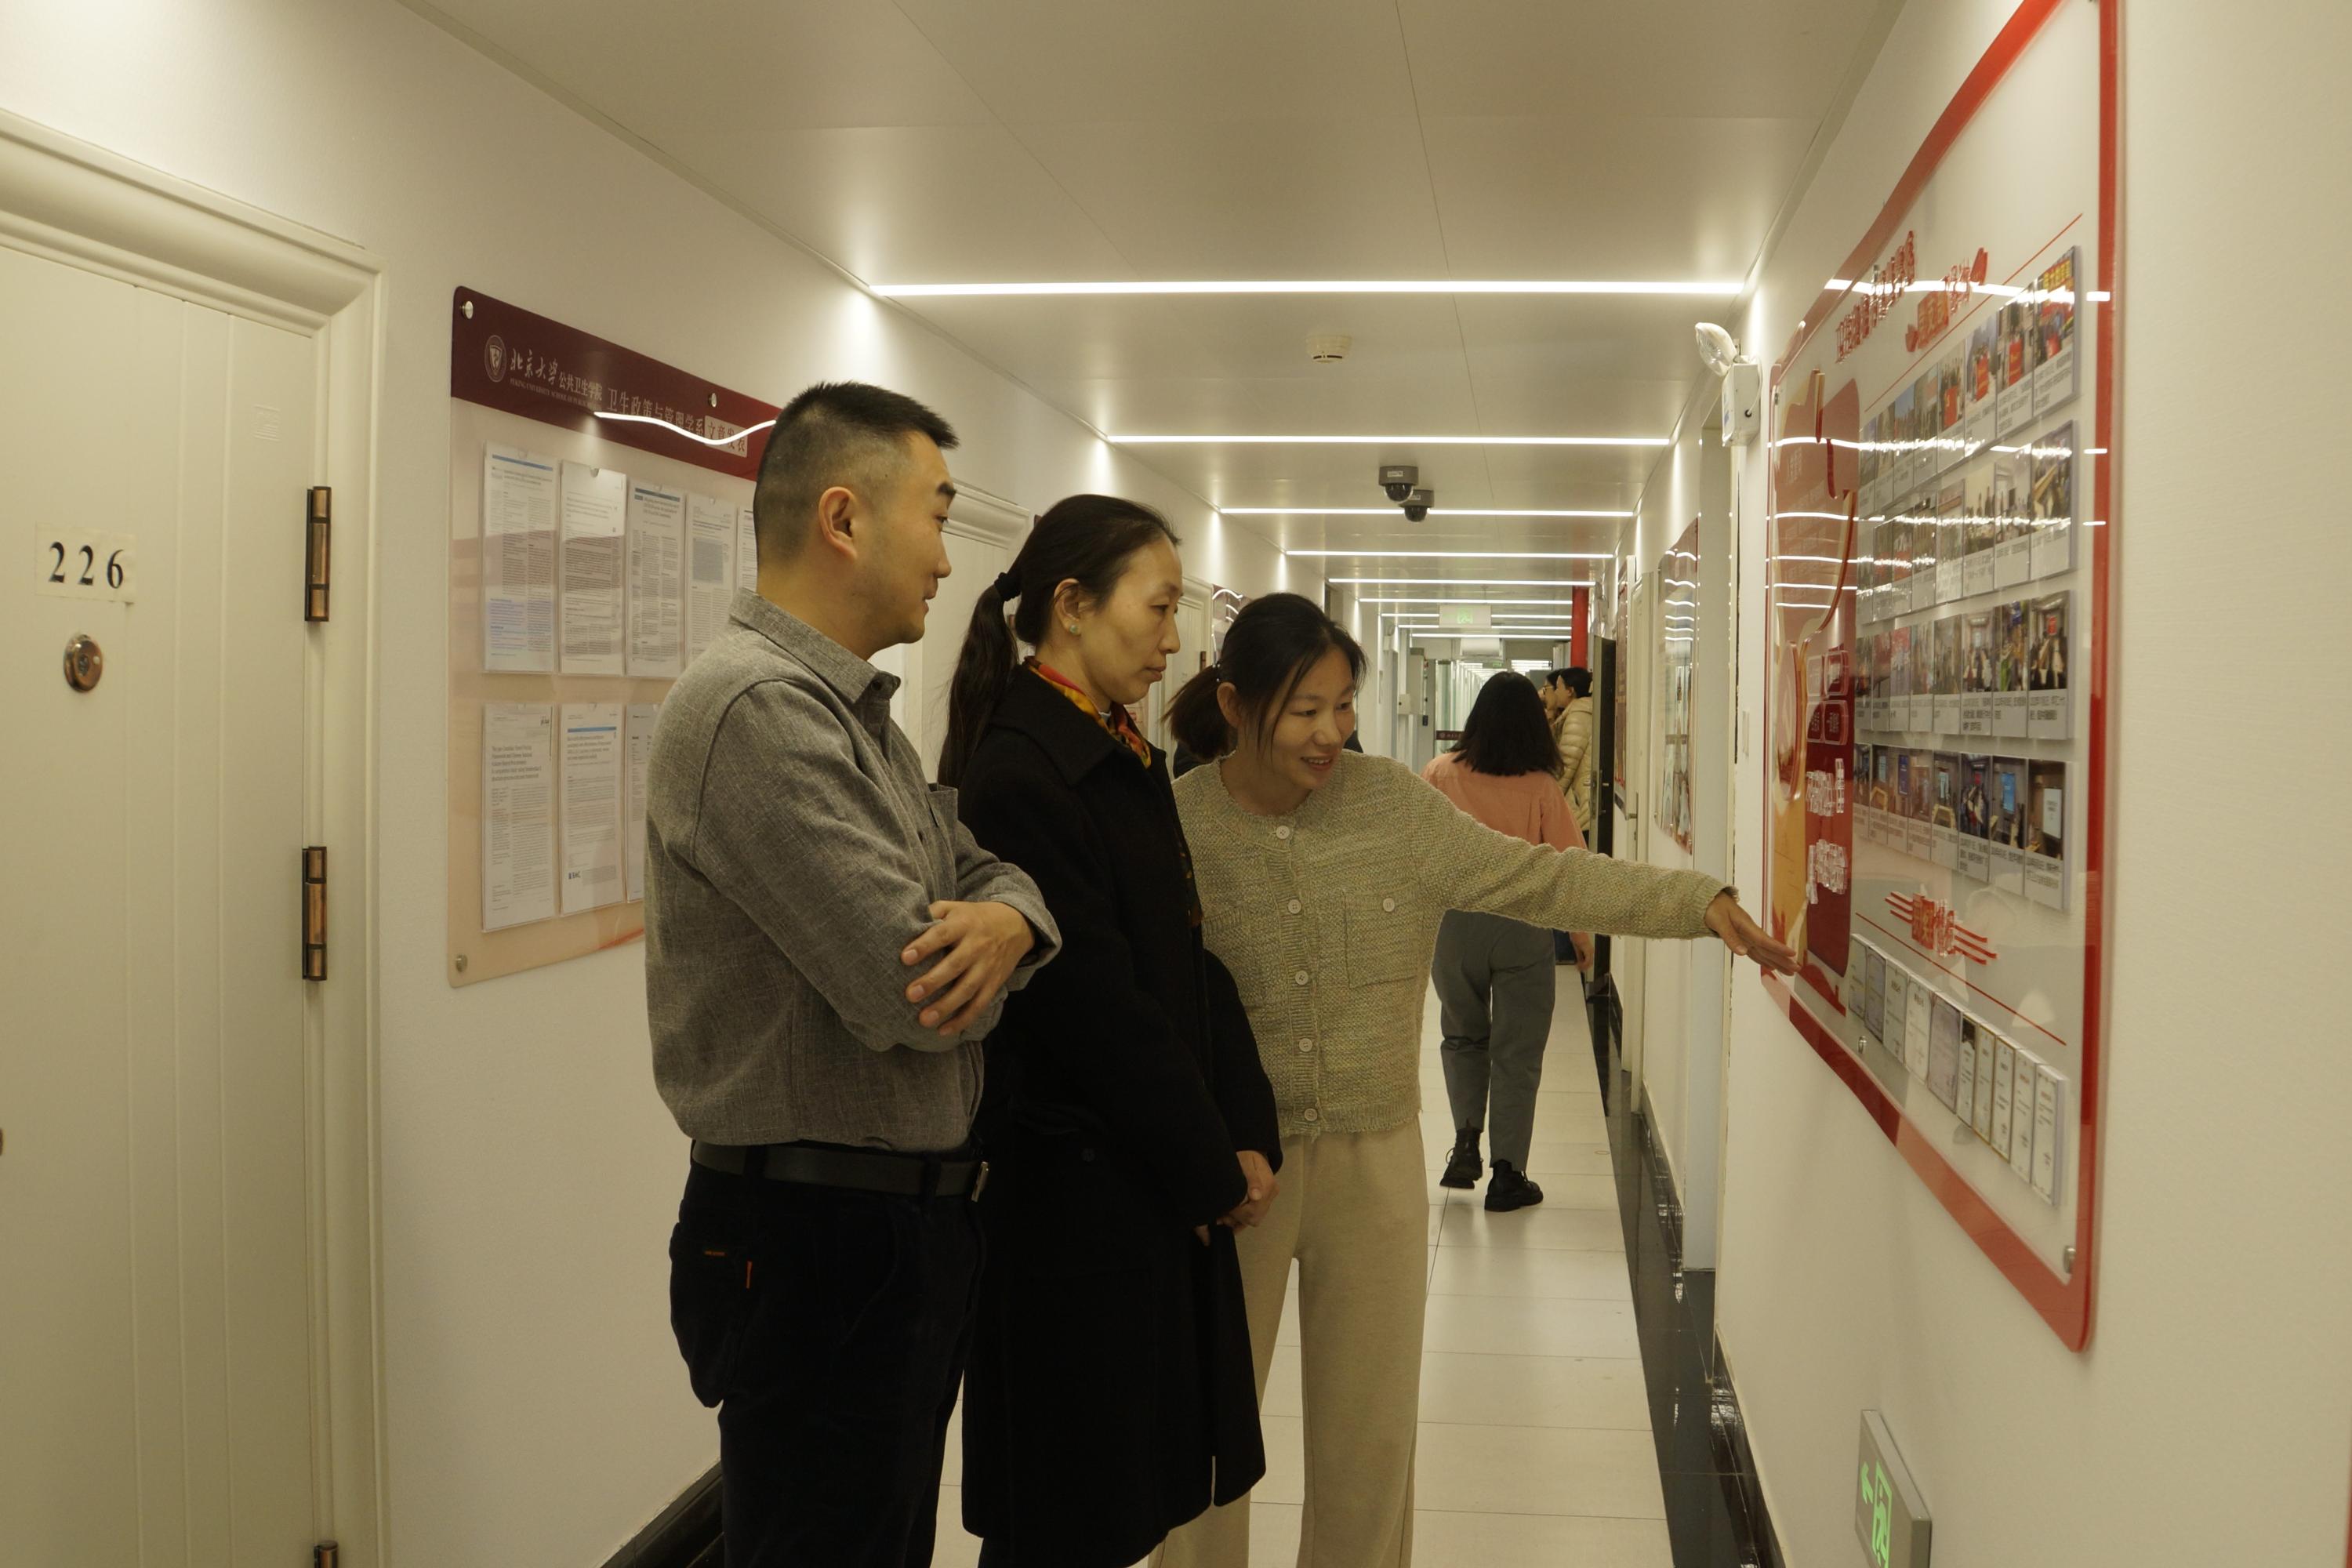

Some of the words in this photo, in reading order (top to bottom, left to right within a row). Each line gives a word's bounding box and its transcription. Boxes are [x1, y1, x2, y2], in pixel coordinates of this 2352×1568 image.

[509, 348, 559, 383] 北京大学
[607, 388, 704, 436] 卫生政策与管理学系
[49, 541, 124, 589] 226
